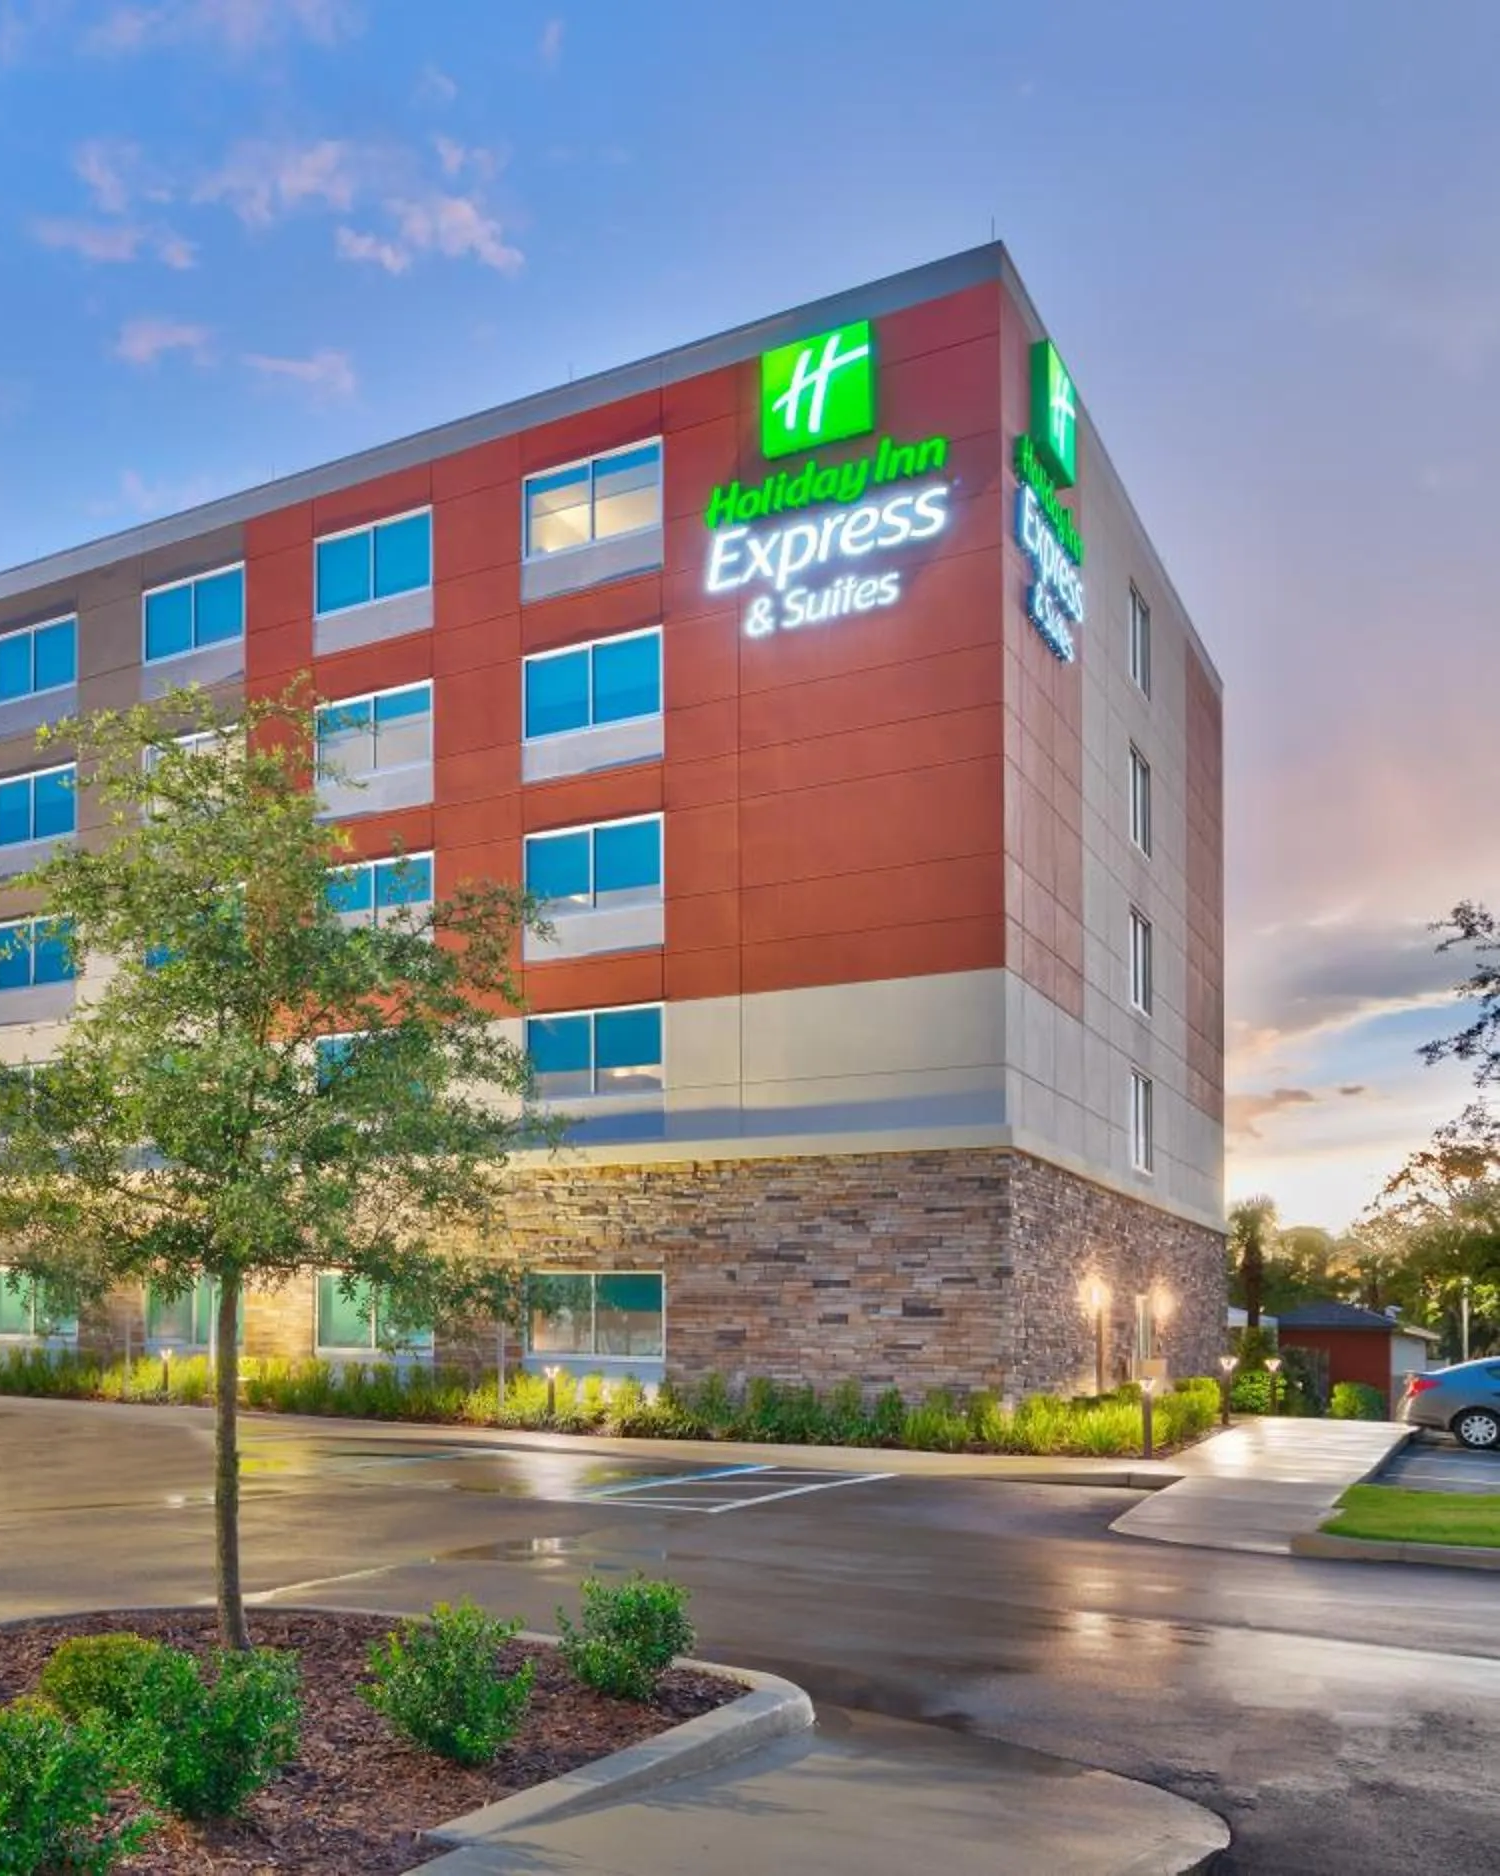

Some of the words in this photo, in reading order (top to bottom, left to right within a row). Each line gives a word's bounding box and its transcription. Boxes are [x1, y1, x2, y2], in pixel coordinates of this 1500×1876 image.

[771, 333, 869, 433] H
[706, 458, 869, 529] Holiday
[874, 435, 949, 483] Inn
[706, 487, 948, 593] Express
[1022, 484, 1084, 623] Express
[745, 596, 774, 638] &
[780, 571, 900, 629] Suites
